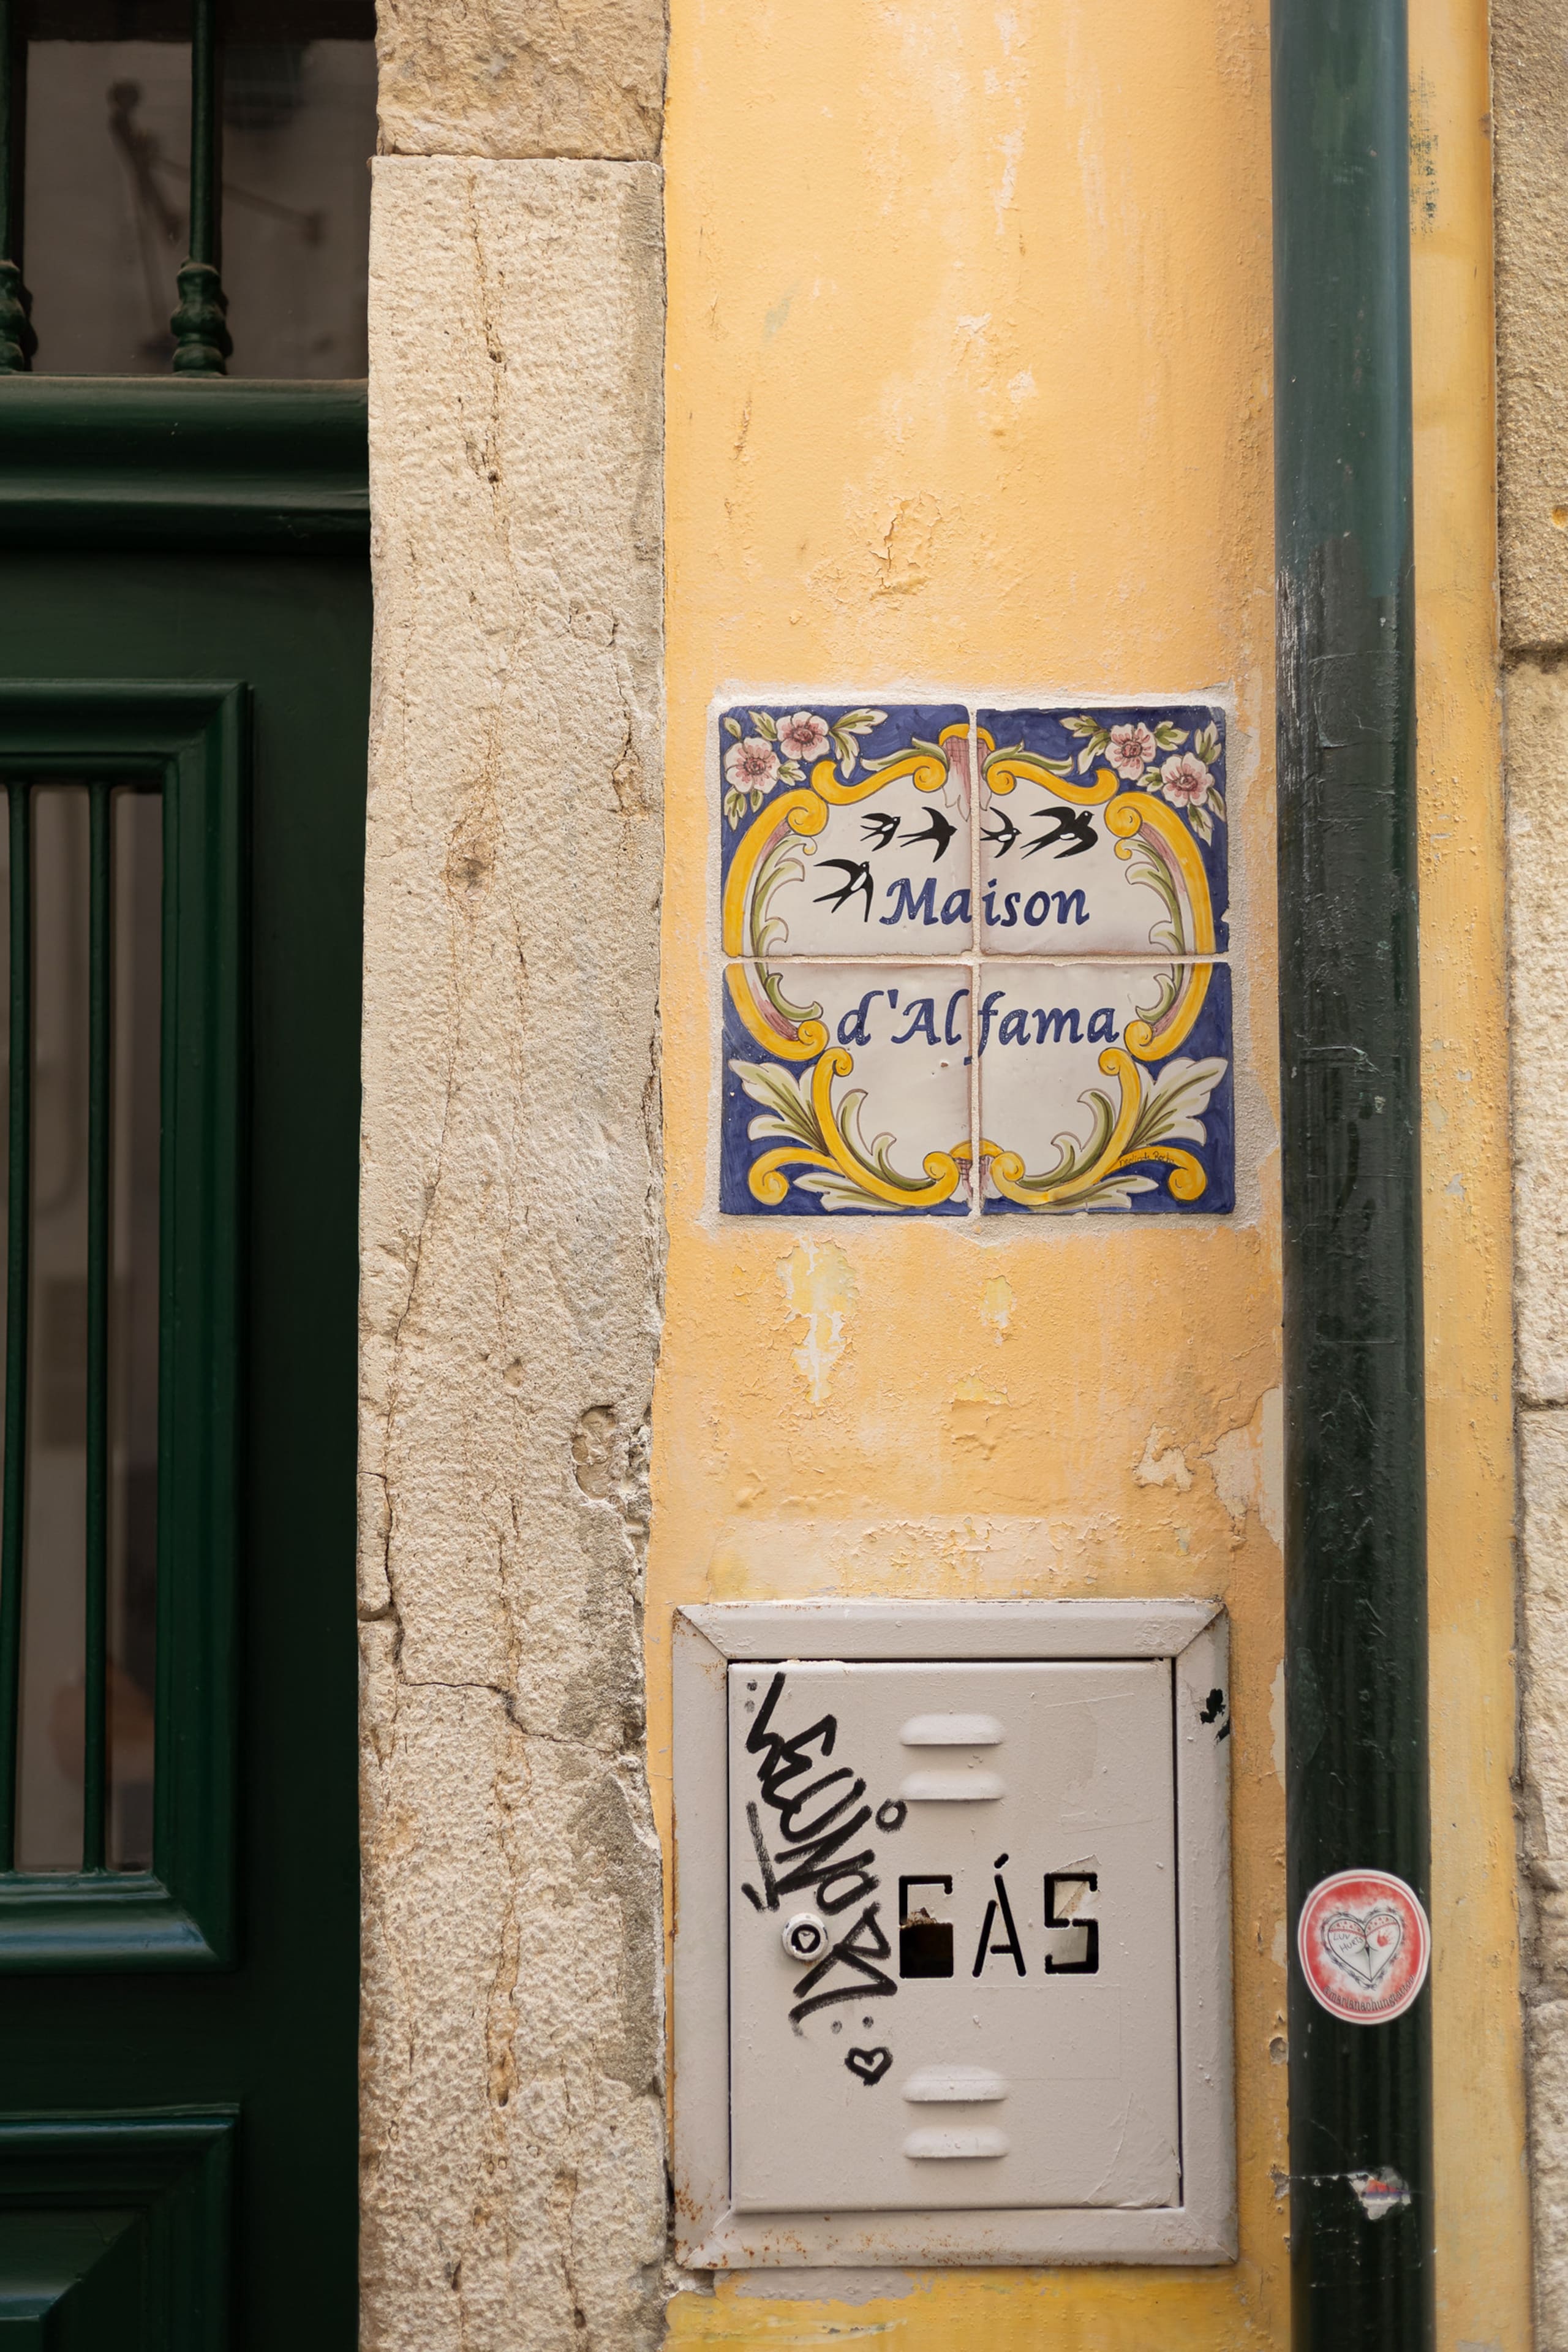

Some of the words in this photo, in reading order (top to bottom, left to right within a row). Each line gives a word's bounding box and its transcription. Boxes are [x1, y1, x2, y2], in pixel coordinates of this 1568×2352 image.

[880, 877, 1090, 926] Maison
[837, 988, 1120, 1065] d'Alfama
[1333, 1932, 1351, 1942] LUV
[1339, 1937, 1364, 1953] HURTS
